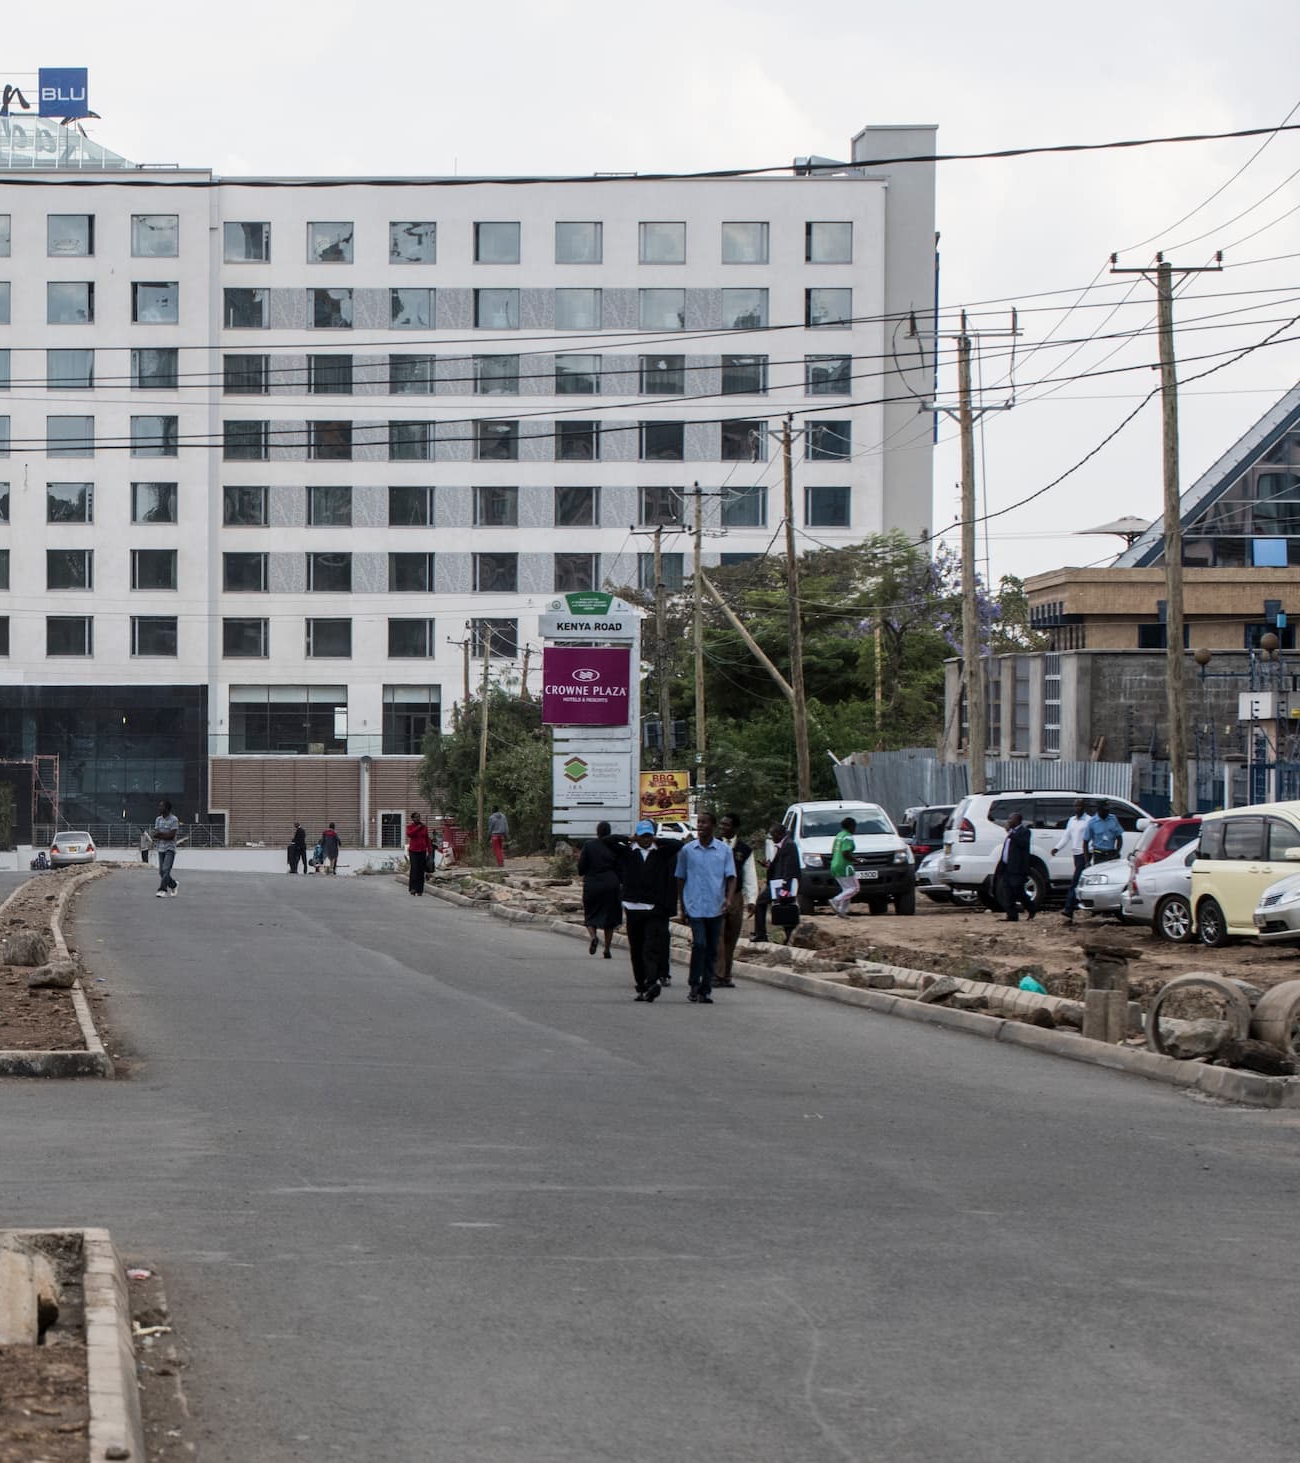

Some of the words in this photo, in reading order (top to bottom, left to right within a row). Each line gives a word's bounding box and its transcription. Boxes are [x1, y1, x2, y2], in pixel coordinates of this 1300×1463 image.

[41, 87, 86, 101] BLU
[556, 622, 591, 631] KENYA
[594, 622, 622, 631] ROAD
[545, 685, 589, 695] CROWNE
[593, 686, 627, 696] PLAZA
